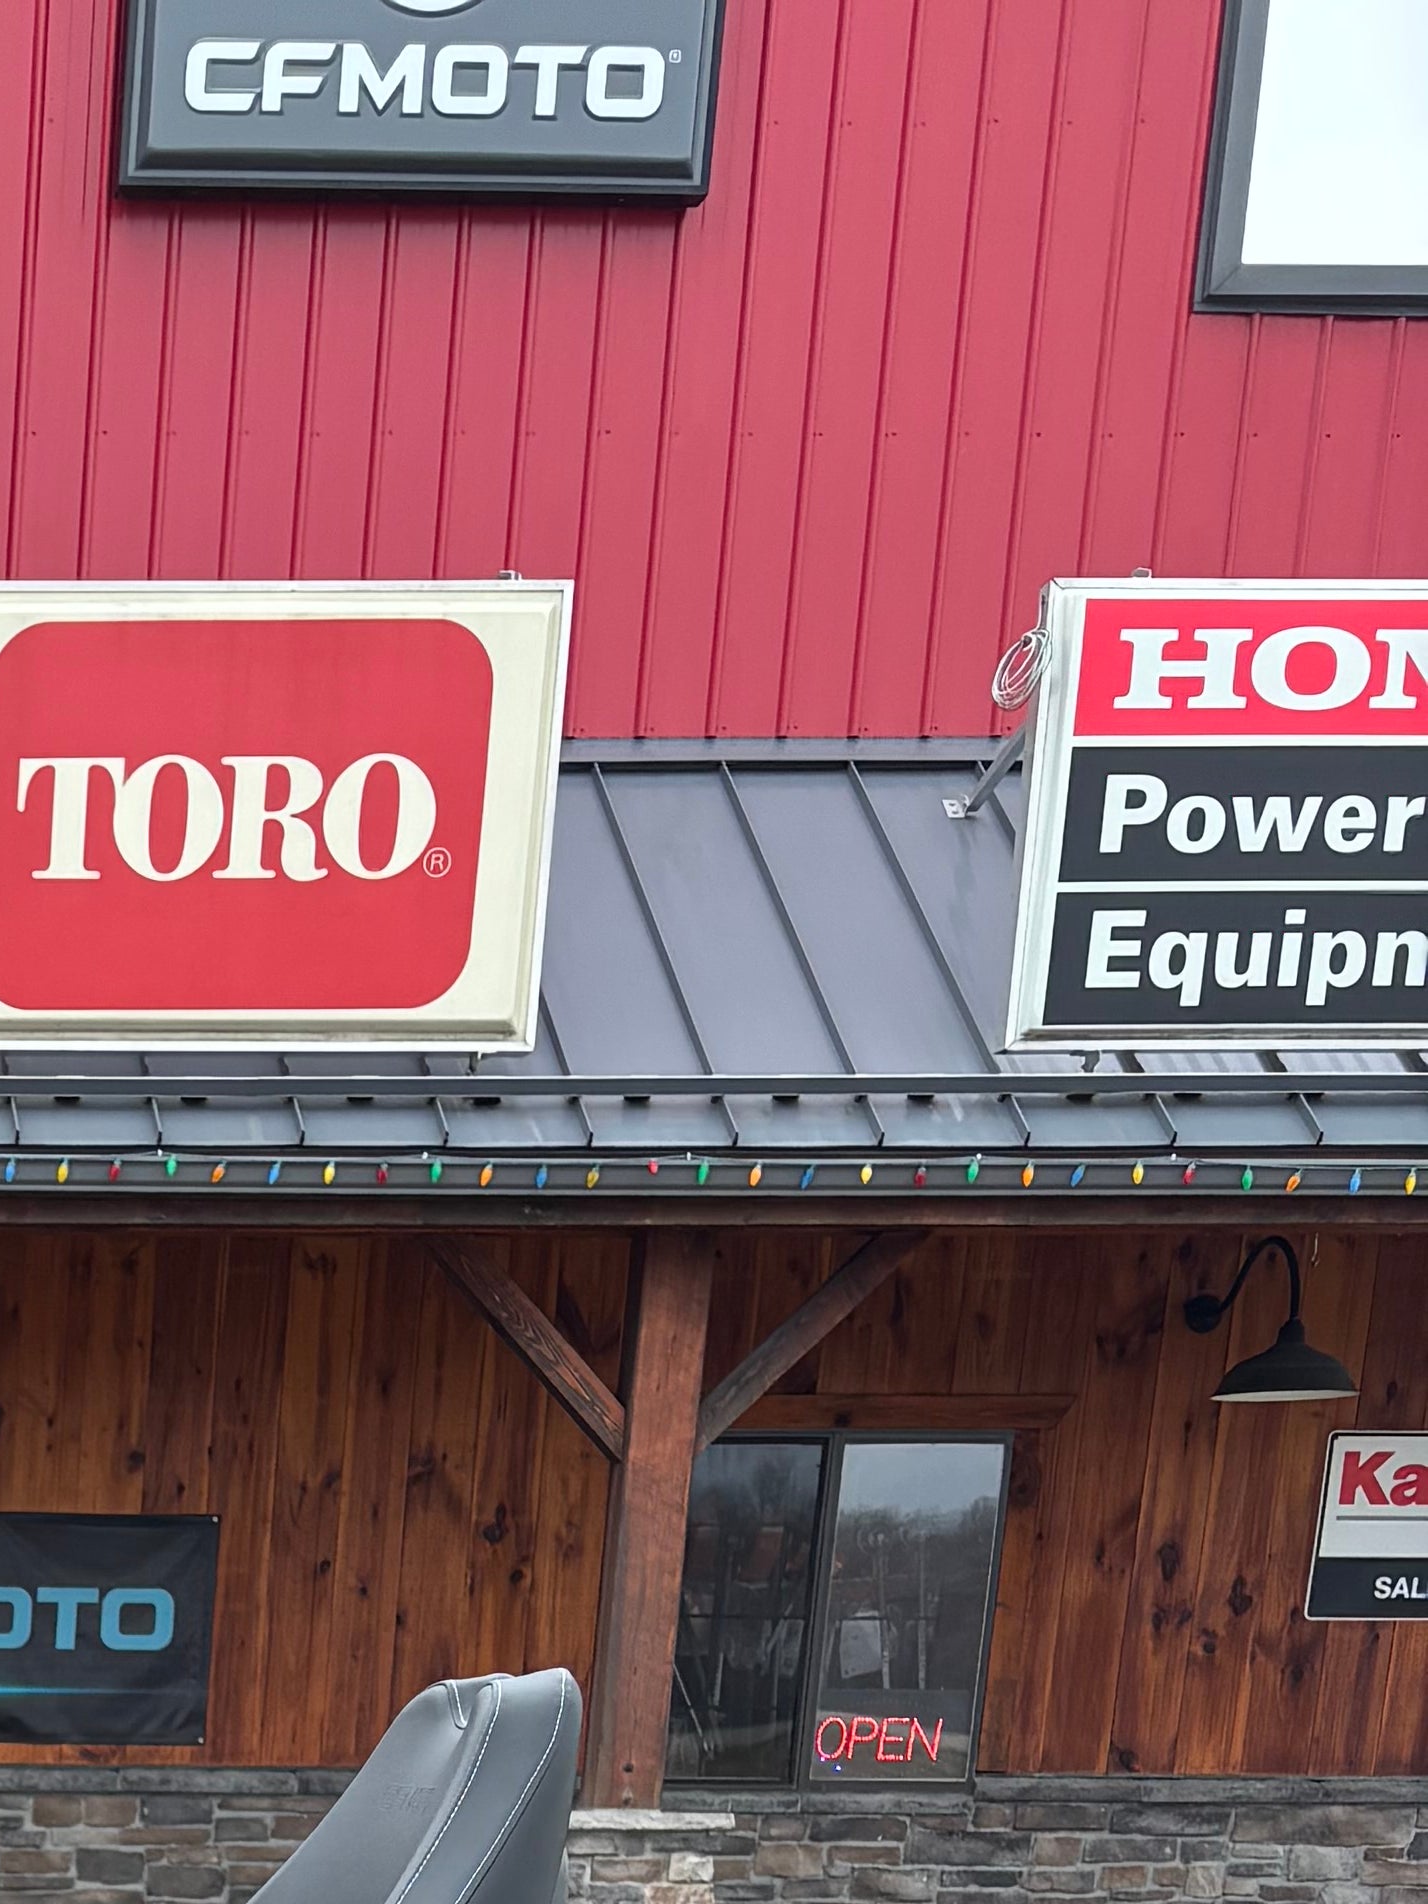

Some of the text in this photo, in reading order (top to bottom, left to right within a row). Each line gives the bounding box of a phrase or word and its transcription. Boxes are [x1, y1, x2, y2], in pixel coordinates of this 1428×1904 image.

[184, 40, 665, 119] CFMOTO
[17, 753, 436, 882] TORO
[1098, 774, 1426, 854] Power
[815, 1715, 943, 1761] OPEN
